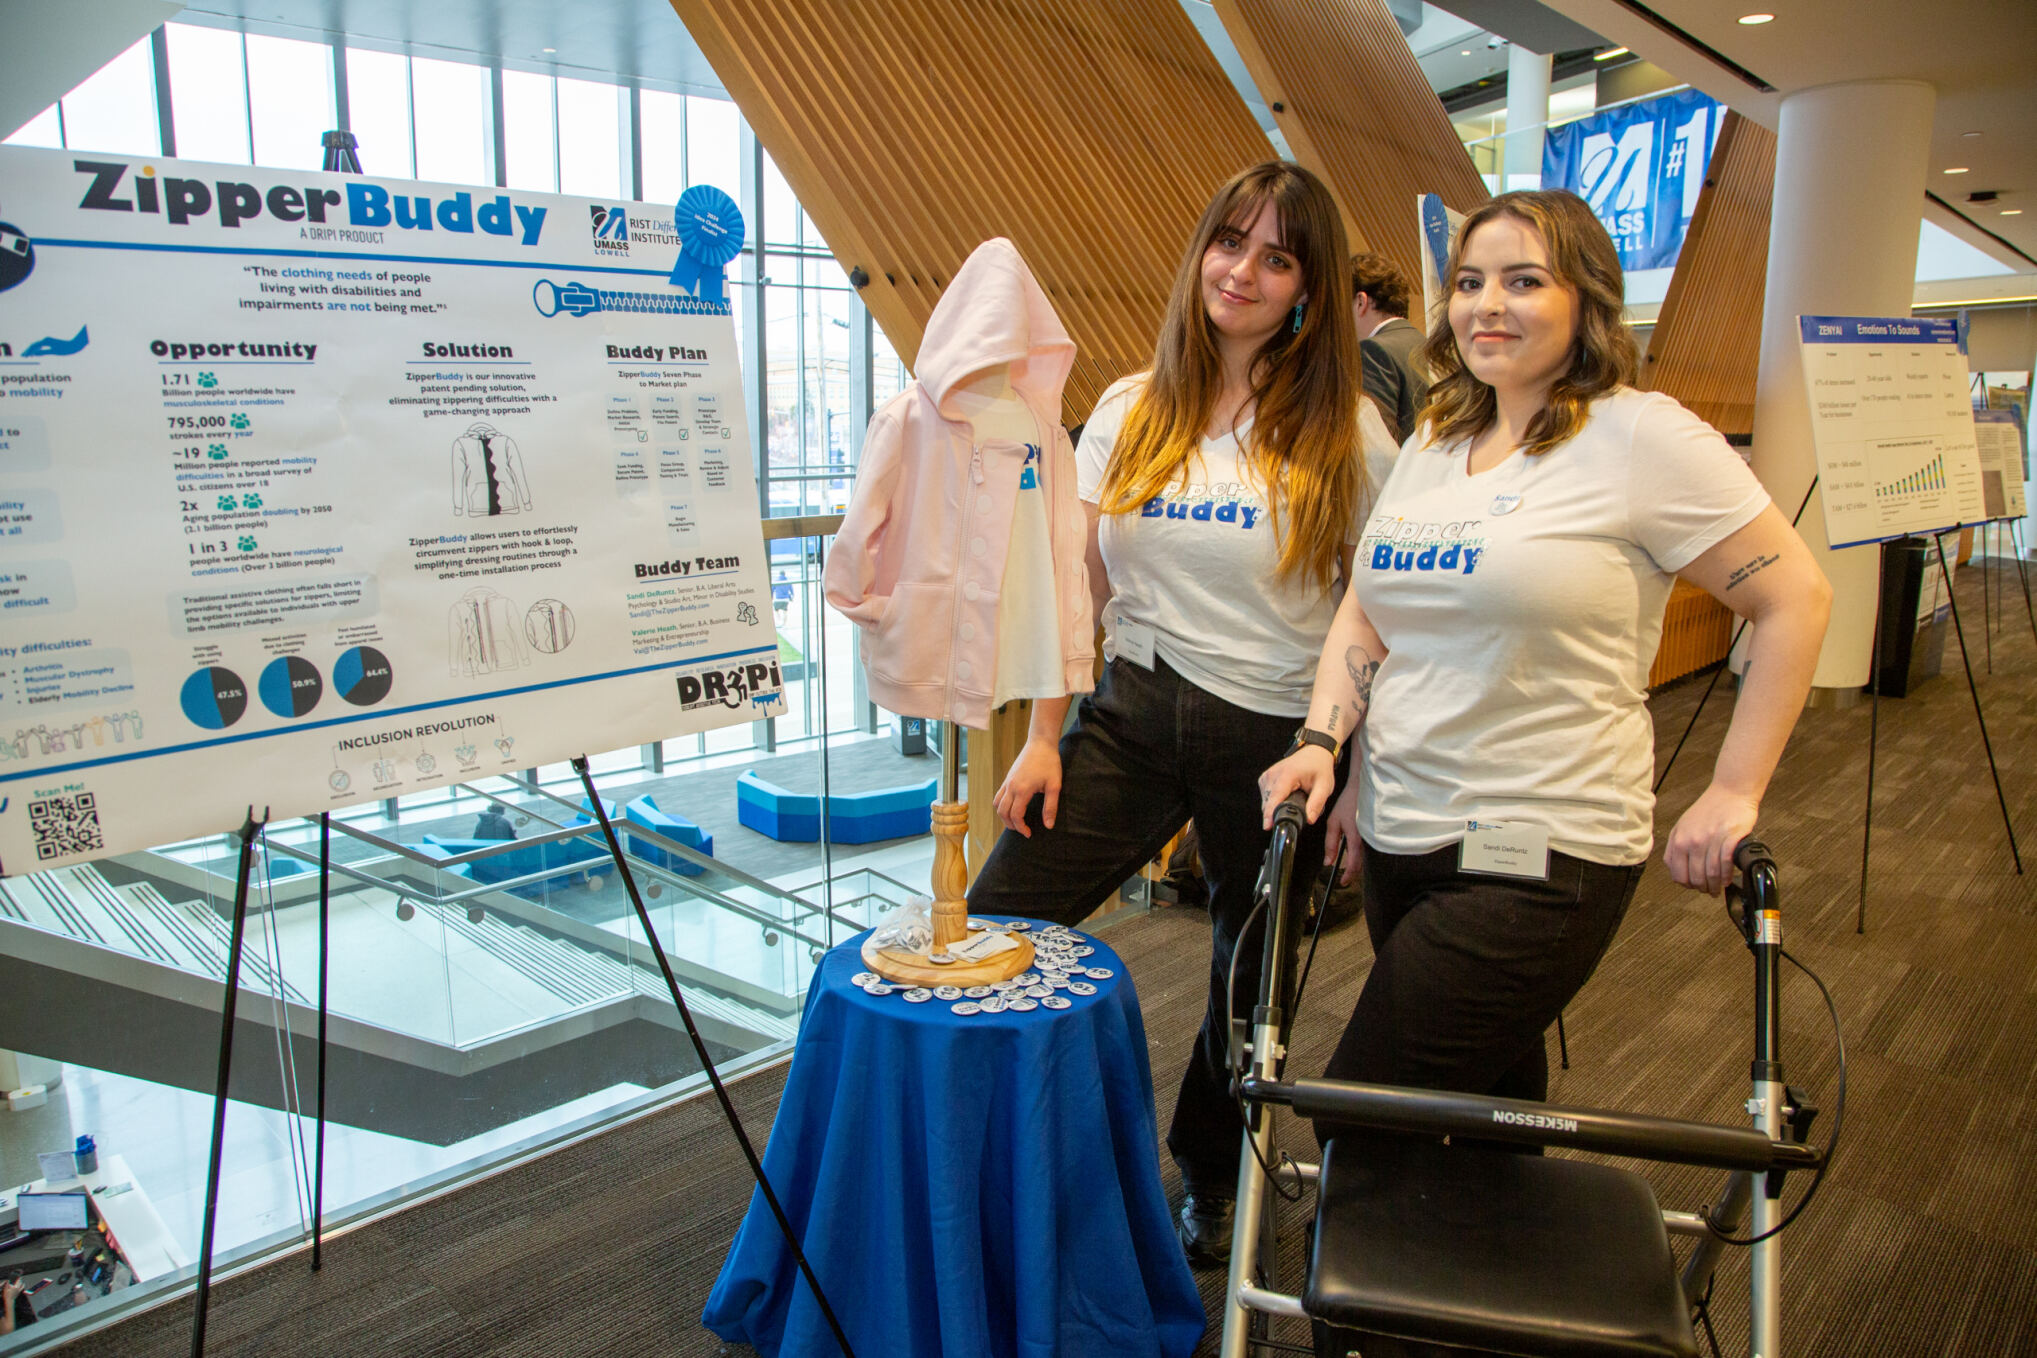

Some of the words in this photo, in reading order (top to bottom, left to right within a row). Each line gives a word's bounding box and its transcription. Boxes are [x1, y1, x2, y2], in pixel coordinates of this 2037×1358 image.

[73, 159, 548, 246] ZipperBuddy
[630, 218, 651, 230] RIST
[300, 227, 307, 240] A
[339, 229, 384, 245] PRODUCT
[631, 233, 682, 246] INSTITUTE
[594, 240, 630, 251] UMASS
[595, 249, 630, 257] LOWELL
[281, 267, 334, 281] clothing
[337, 271, 372, 281] needs
[376, 272, 389, 281] of
[392, 273, 431, 284] people
[260, 283, 296, 296] living
[299, 283, 328, 295] with
[332, 285, 397, 297] disabilities
[400, 288, 422, 298] and
[239, 298, 324, 312] impairments
[327, 302, 347, 311] are
[350, 302, 372, 311] not
[375, 302, 408, 315] being
[1857, 323, 1887, 336] Emotions
[1888, 324, 1896, 336] To
[1897, 325, 1920, 336] Sounds
[150, 340, 318, 361] Opportunity
[423, 342, 514, 358] Solution
[606, 344, 664, 362] Buddy
[669, 346, 708, 360] Plan
[1, 374, 72, 385] population
[162, 373, 190, 385] 1.71
[405, 372, 464, 383] ZipperBuddy
[492, 372, 536, 381] innovative
[618, 370, 662, 380] ZipperBuddy
[663, 371, 682, 379] Seven
[421, 385, 451, 394] patent
[453, 383, 488, 394] pending
[489, 384, 526, 393] solution,
[648, 380, 672, 388] Market
[673, 381, 687, 389] plan
[9, 387, 64, 399] mobility
[162, 388, 192, 397] Billion
[195, 389, 225, 398] people
[228, 388, 273, 397] worldwide
[275, 388, 296, 396] have
[164, 399, 238, 408] musculoskeletal
[239, 398, 285, 407] conditions
[389, 396, 441, 407] eliminating
[443, 395, 484, 406] zippering
[485, 394, 530, 404] difficulties
[532, 394, 550, 402] with
[423, 407, 490, 419] game-changing
[492, 406, 531, 416] approach
[168, 415, 227, 430] 795,000
[7, 428, 20, 438] to
[170, 431, 204, 440] strokes
[206, 431, 232, 440] every
[235, 431, 254, 439] year
[175, 461, 206, 471] Million
[209, 460, 240, 470] people
[241, 459, 280, 468] reported
[282, 457, 318, 466] mobility
[176, 473, 224, 482] difficulties
[245, 469, 271, 478] broad
[273, 467, 302, 477] survey
[178, 484, 198, 493] U.S.
[200, 482, 234, 492] citizens
[236, 480, 257, 488] over
[180, 500, 199, 511] 2x
[12, 514, 33, 523] use
[183, 513, 210, 524] Aging
[211, 510, 261, 521] population
[262, 507, 300, 517] doubling
[1142, 497, 1257, 529] Buddy
[204, 522, 233, 532] billion
[235, 519, 269, 531] people)
[1367, 515, 1482, 545] Zipper
[409, 534, 468, 547] ZipperBuddy
[470, 532, 496, 542] allows
[498, 530, 520, 540] users
[533, 525, 578, 537] effortlessly
[201, 542, 216, 553] in
[220, 540, 228, 552] 3
[416, 546, 466, 558] circumvent
[468, 544, 499, 554] zippers
[501, 541, 520, 550] with
[522, 538, 542, 548] hook
[190, 556, 221, 567] people
[223, 552, 270, 563] worldwide
[271, 551, 292, 559] have
[294, 546, 344, 557] neurological
[414, 558, 463, 571] simplifying
[465, 554, 501, 566] dressing
[502, 552, 537, 562] routines
[539, 548, 571, 559] through
[1371, 544, 1483, 574] Buddy
[192, 566, 240, 577] conditions
[241, 562, 267, 575] (Over
[276, 559, 303, 569] billion
[304, 556, 336, 567] people)
[438, 569, 480, 580] one-time
[481, 564, 529, 576] installation
[531, 560, 562, 572] process
[634, 561, 691, 578] Buddy
[695, 556, 740, 571] Team
[183, 593, 228, 605] Traditional
[230, 590, 263, 600] assistive
[264, 587, 294, 598] clothing
[333, 581, 353, 590] short
[626, 592, 645, 601] Sandi
[3, 597, 50, 610] difficult
[184, 605, 223, 616] providing
[225, 601, 254, 612] specific
[256, 597, 290, 607] solutions
[202, 613, 232, 624] options
[234, 610, 269, 620] available
[280, 602, 320, 613] individuals
[207, 620, 242, 631] mobility
[243, 615, 285, 627] challenges.
[21, 638, 93, 655] difficulties:
[23, 662, 64, 675] Arthritis
[25, 672, 66, 684] Muscular
[68, 667, 115, 679] Dystrophy
[26, 683, 61, 695] Injuries
[292, 677, 317, 688] 50.9%
[28, 693, 61, 704] Elderly
[63, 688, 100, 699] Mobility
[102, 683, 135, 695] Decline
[338, 729, 413, 752] INCLUSION
[416, 714, 496, 738] REVOLUTION
[33, 786, 61, 799] Scan
[64, 782, 85, 794] Me!
[1483, 843, 1500, 852] Sandi
